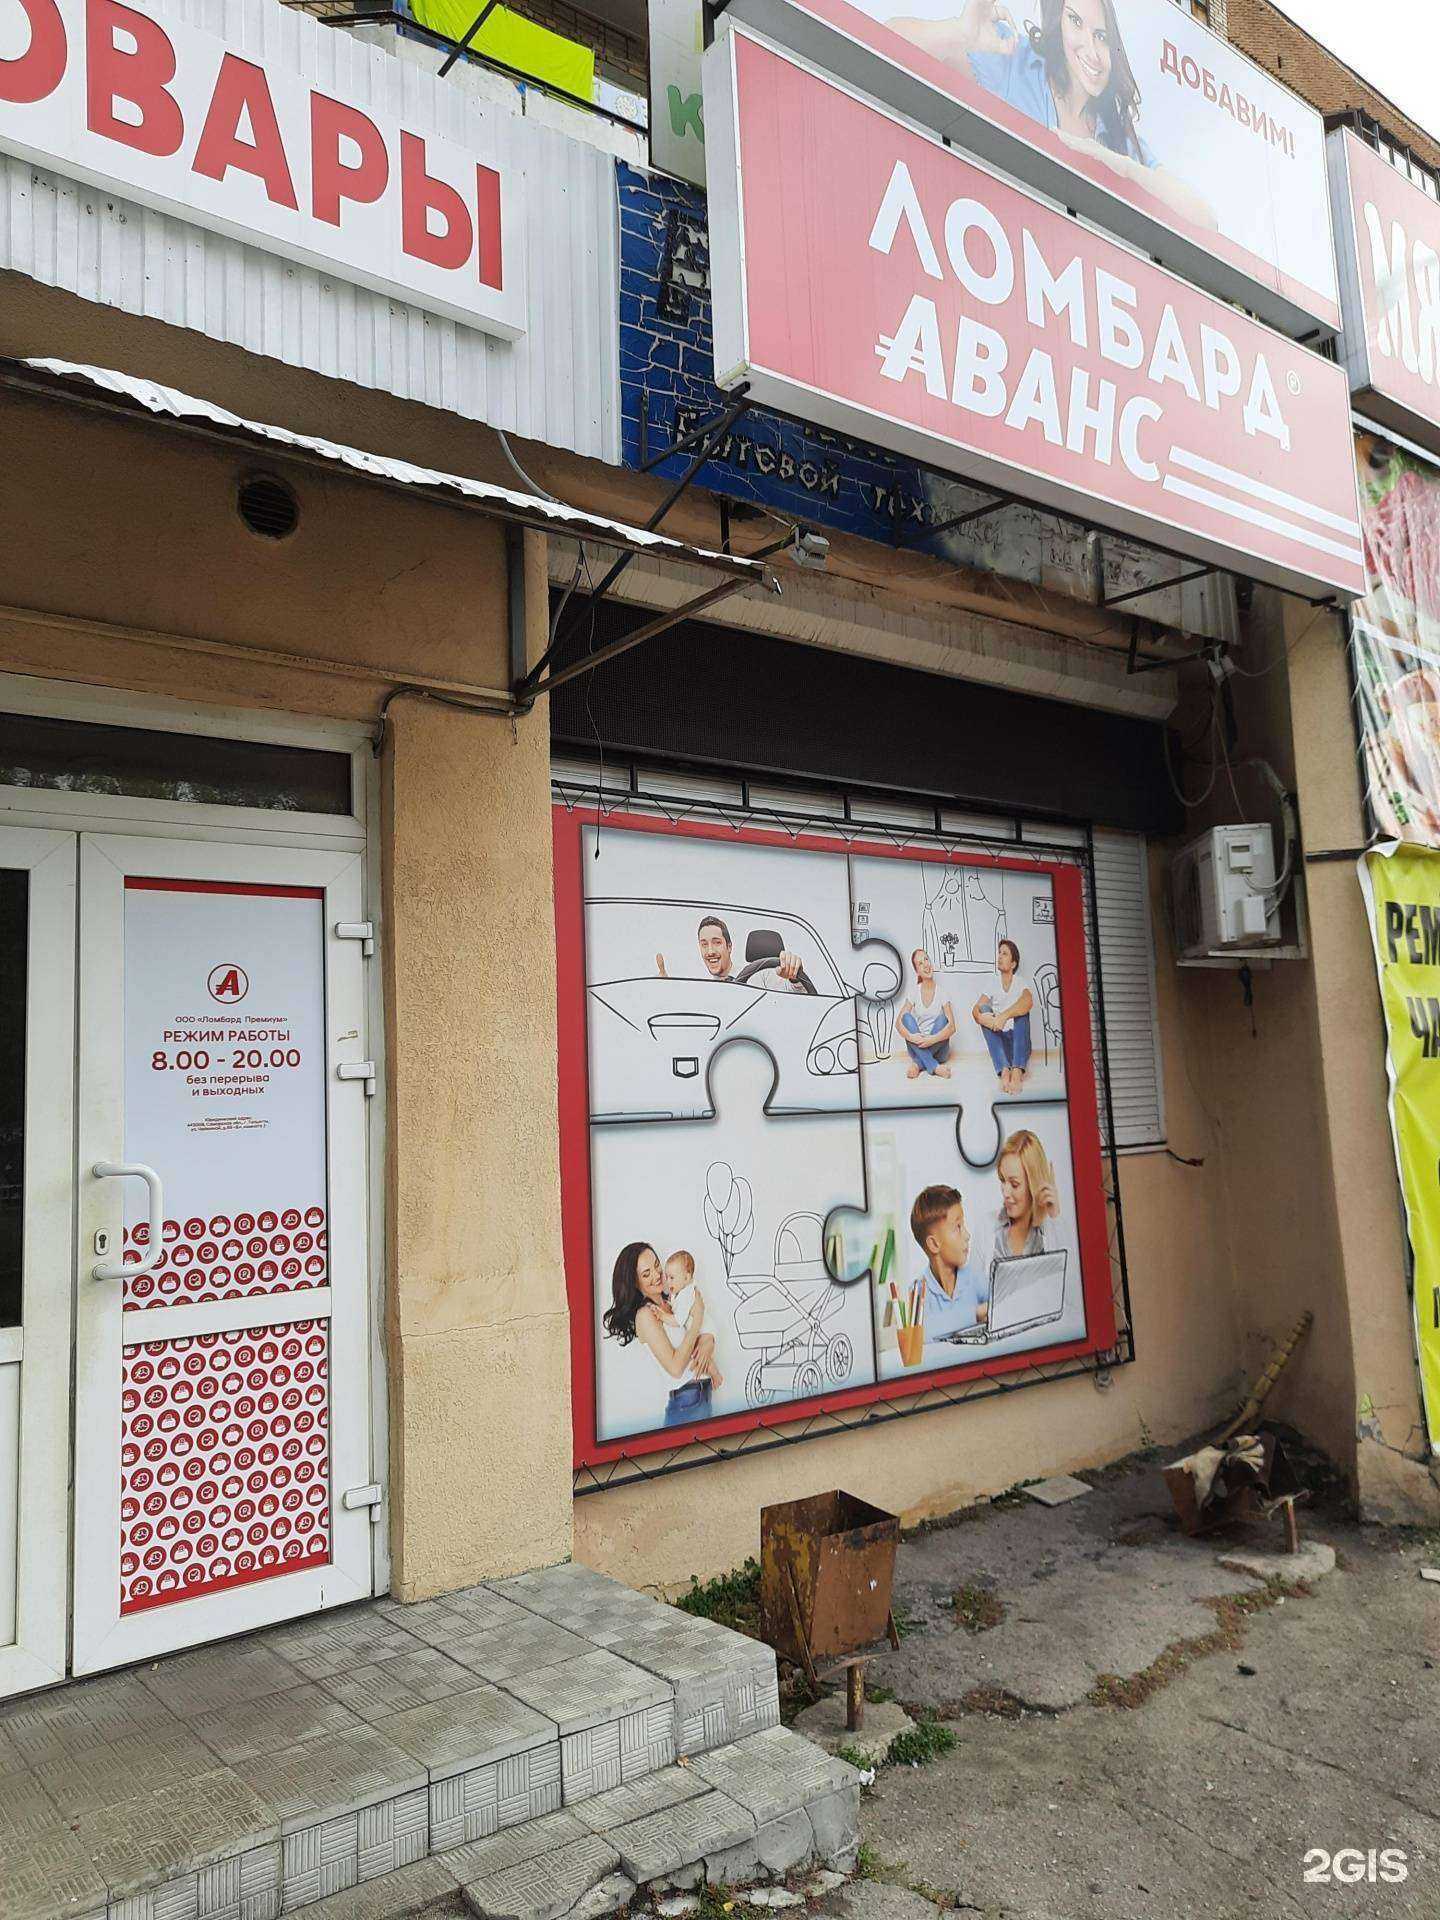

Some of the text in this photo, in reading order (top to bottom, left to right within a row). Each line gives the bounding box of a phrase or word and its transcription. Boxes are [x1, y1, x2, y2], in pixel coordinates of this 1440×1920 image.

[1160, 39, 1295, 160] ДОБАВИМ!
[869, 160, 1291, 452] ЛОМБАРД
[875, 294, 1163, 482] АВАНС
[198, 1015, 242, 1024] «Ломбард
[245, 1015, 288, 1024] Премиум»
[163, 1029, 290, 1043] РЕЖИМ РАБОТЫ
[151, 1051, 210, 1071] 8.00
[232, 1049, 301, 1069] 20.00
[186, 1074, 270, 1086] без перерыва
[192, 1086, 265, 1097] и выходных
